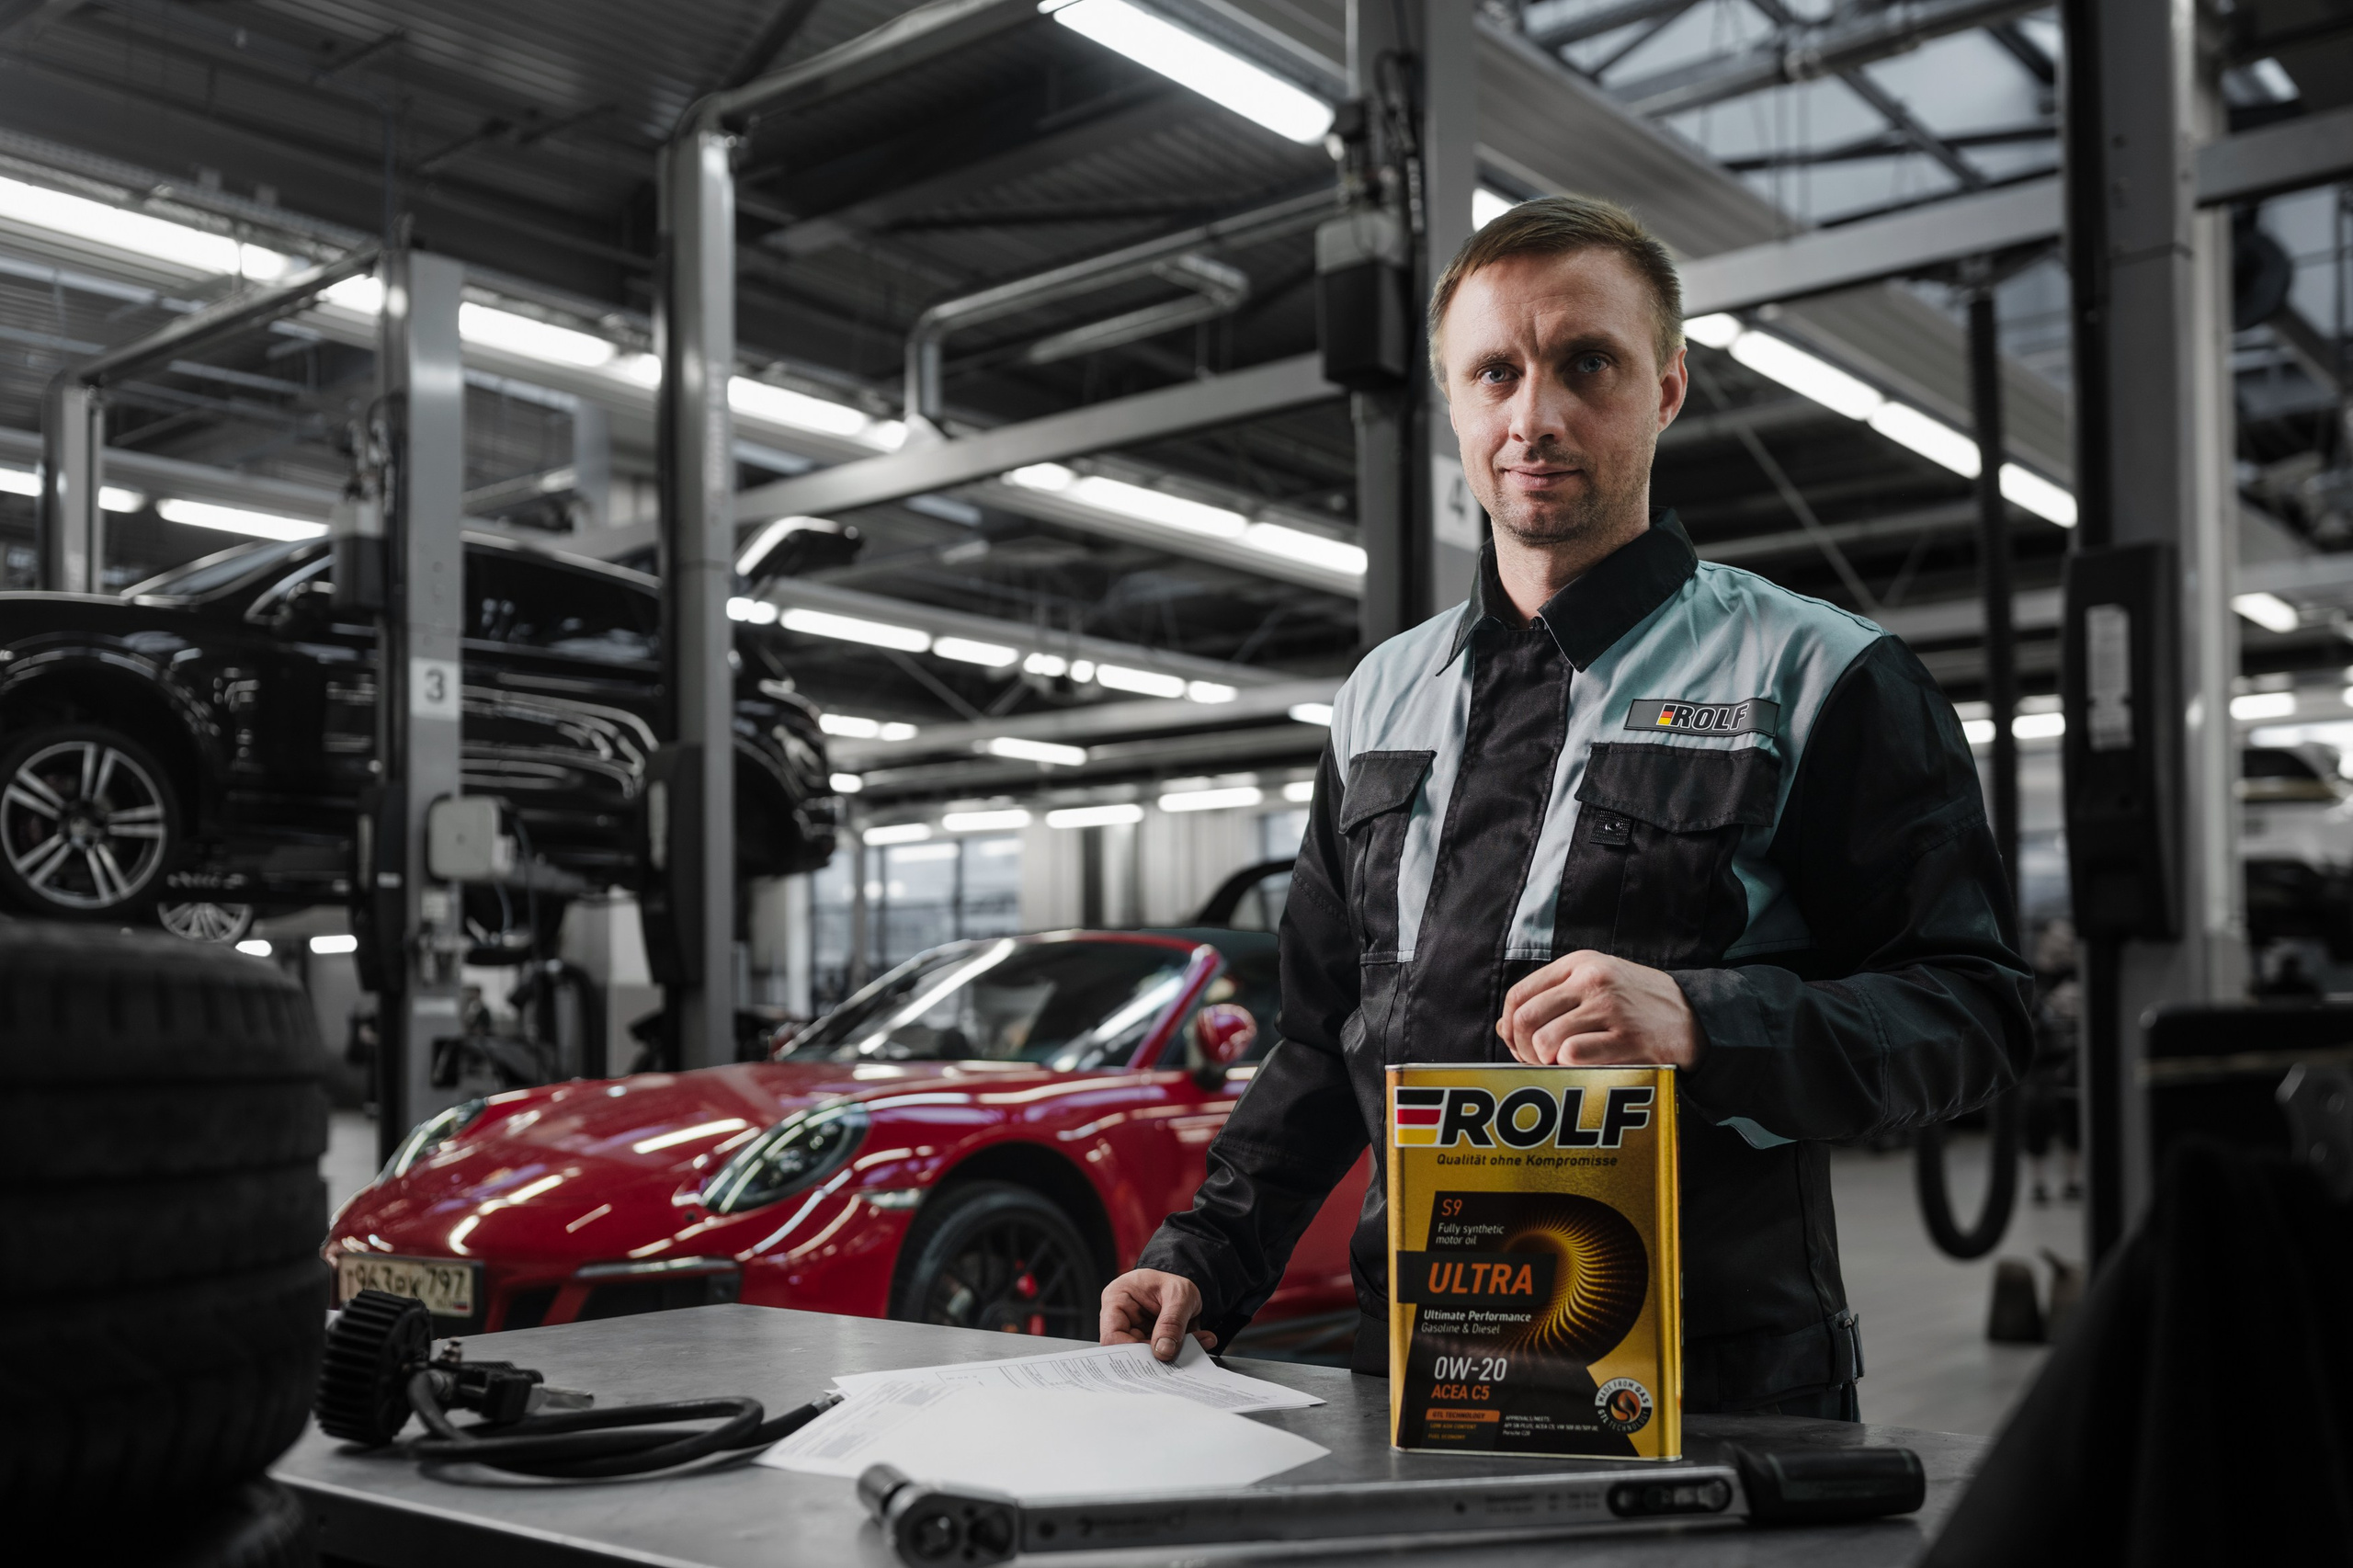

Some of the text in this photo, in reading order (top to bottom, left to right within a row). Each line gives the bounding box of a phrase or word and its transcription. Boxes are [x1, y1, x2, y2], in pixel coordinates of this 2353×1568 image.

[425, 667, 446, 705] 3
[1668, 703, 1750, 731] ROLF
[1438, 1086, 1655, 1150] ROLF
[1436, 1153, 1619, 1169] Qualität ohne Kompromisse
[1440, 1199, 1463, 1217] S9
[1438, 1222, 1505, 1235] Fully synthetic
[1436, 1234, 1477, 1245] motor oil
[425, 1267, 465, 1297] 797
[1427, 1262, 1533, 1296] ULTRA
[1424, 1309, 1532, 1323] Ultimate Performance
[1421, 1322, 1501, 1334] Gasoline & Diesel
[1433, 1356, 1507, 1382] 0W-20
[1430, 1384, 1491, 1400] ACEA C5
[1597, 1380, 1650, 1403] MADE FROM GAS
[1597, 1408, 1609, 1424] GTL
